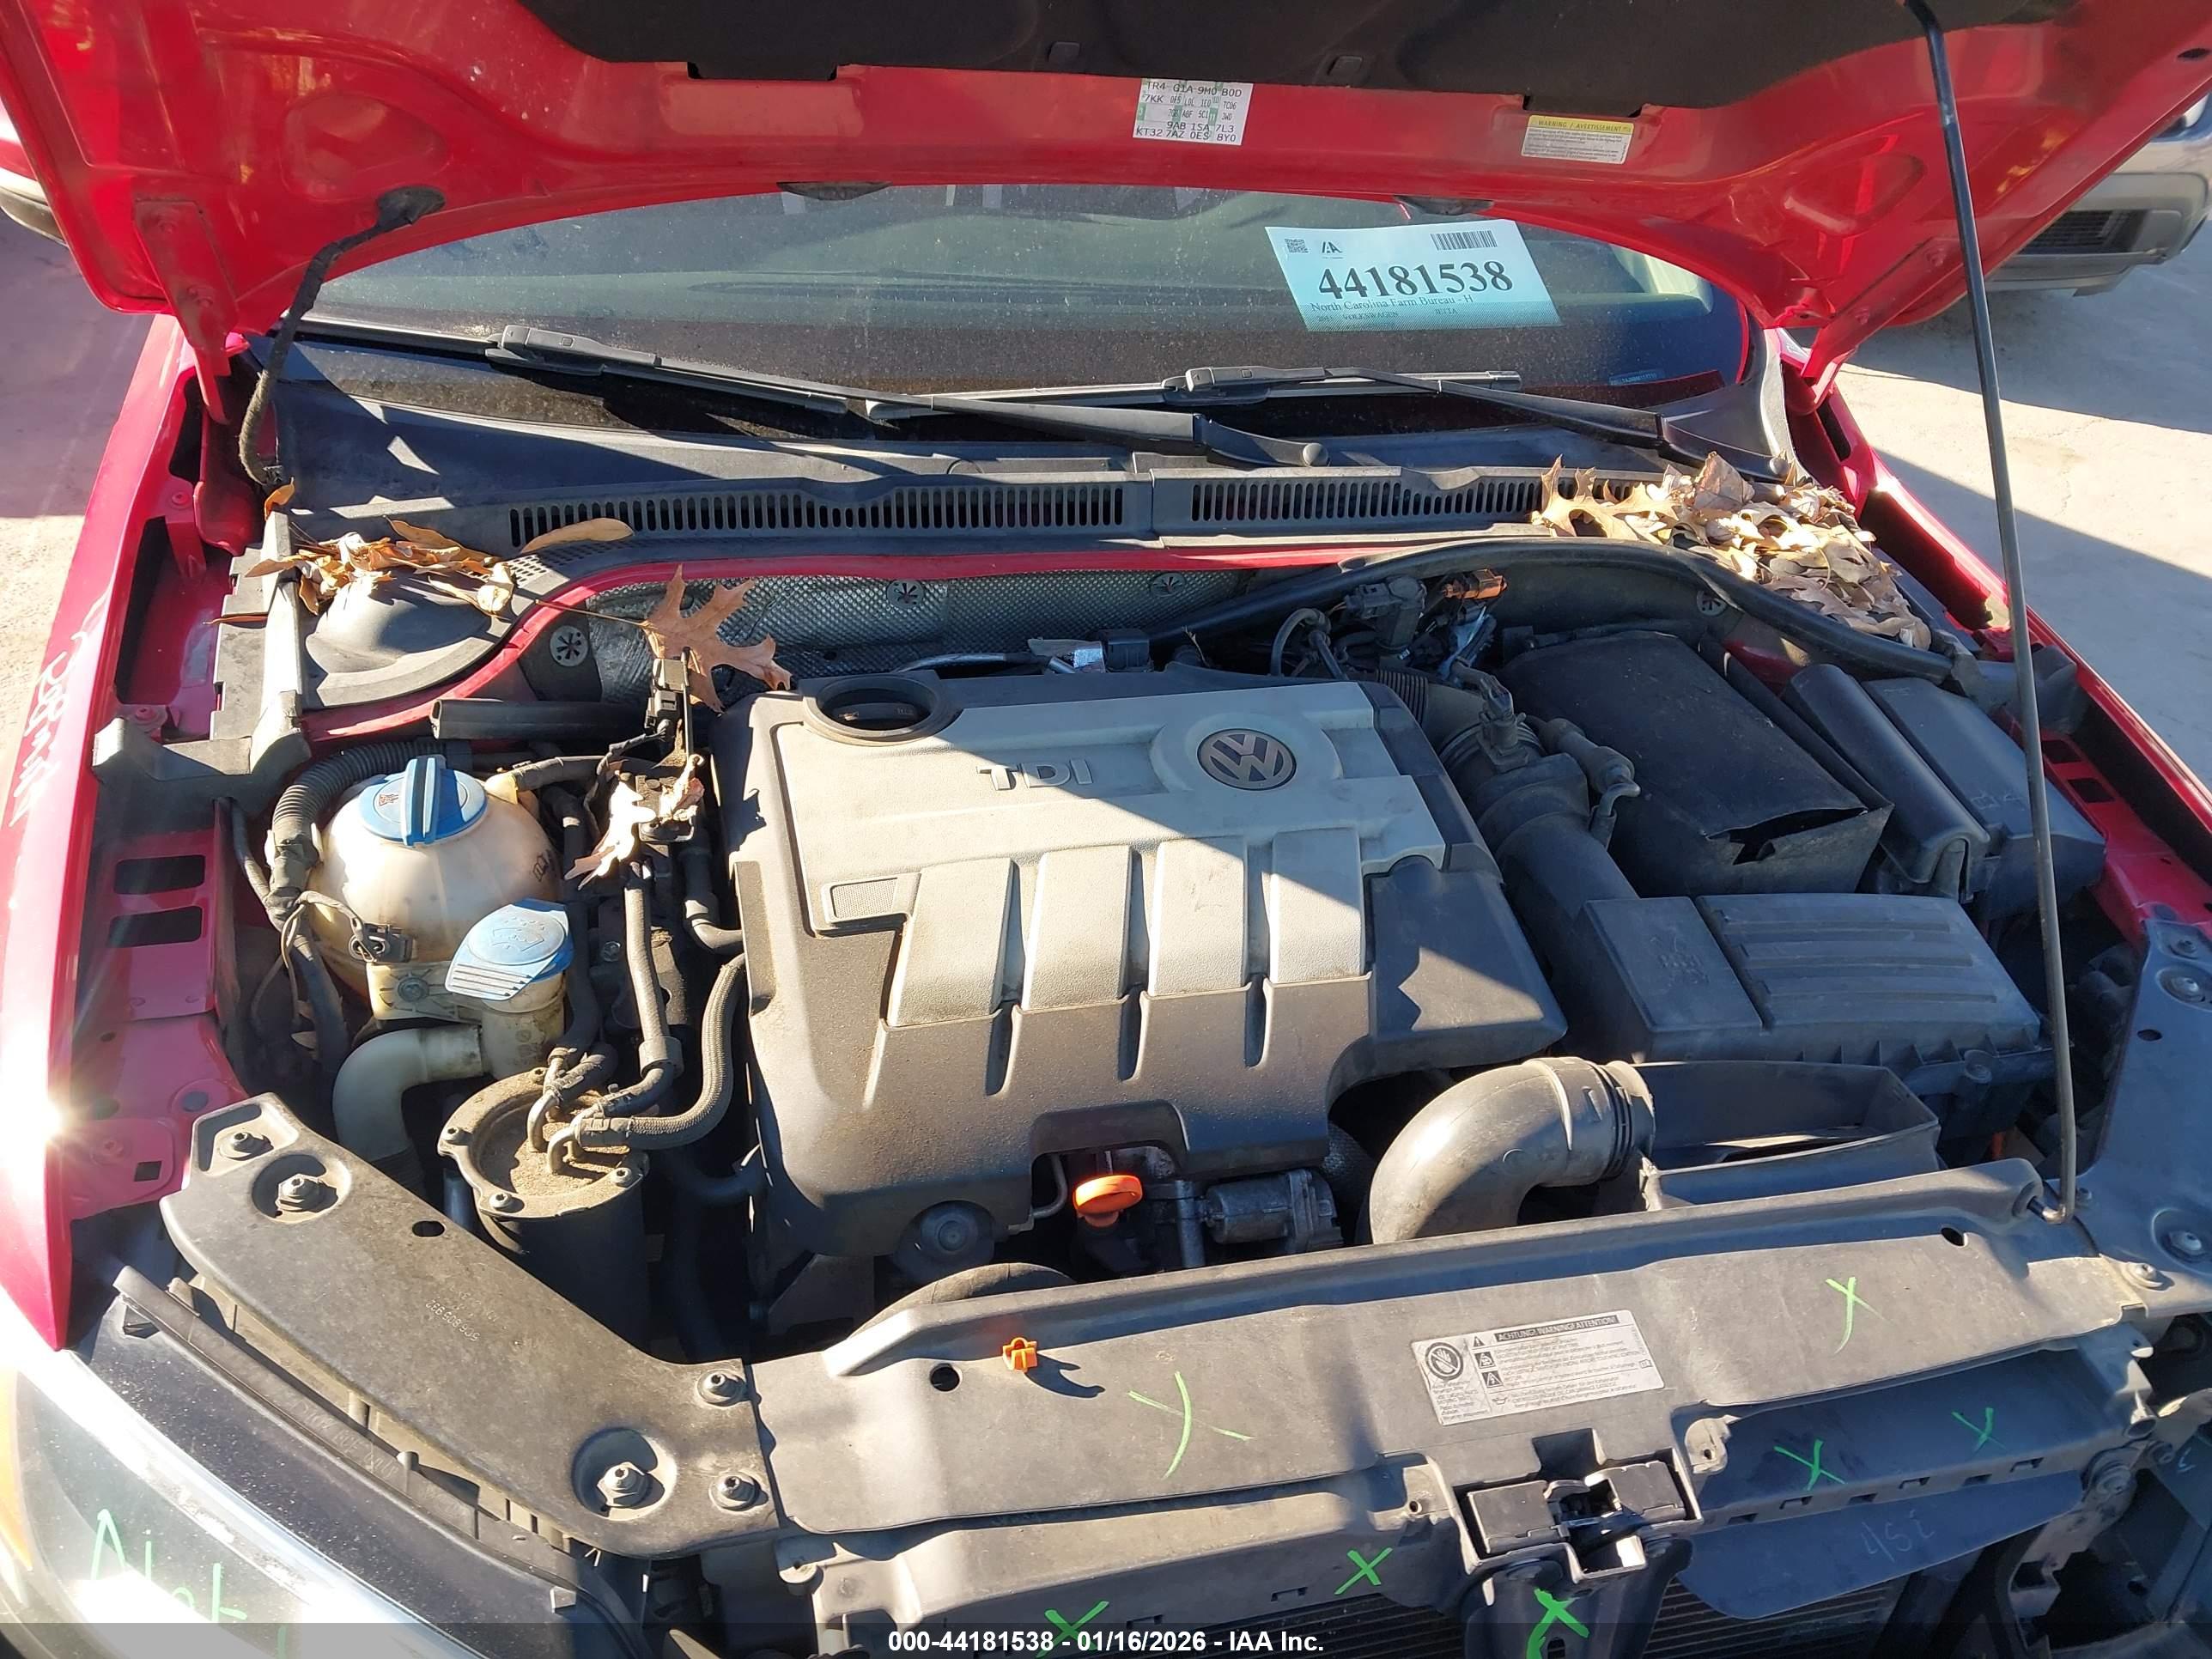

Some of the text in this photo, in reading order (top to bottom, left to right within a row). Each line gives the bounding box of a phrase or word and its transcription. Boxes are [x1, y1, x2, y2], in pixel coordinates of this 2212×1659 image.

[1538, 119, 1567, 128] WARNING
[1577, 123, 1622, 132] AVERTISSEMENT
[1318, 260, 1514, 300] 44181538
[1310, 301, 1342, 312] North
[1343, 299, 1389, 310] Carolina
[1389, 297, 1419, 307] Farm
[1419, 297, 1455, 306] Bureau
[1463, 294, 1474, 303] H
[976, 758, 1094, 791] TDI
